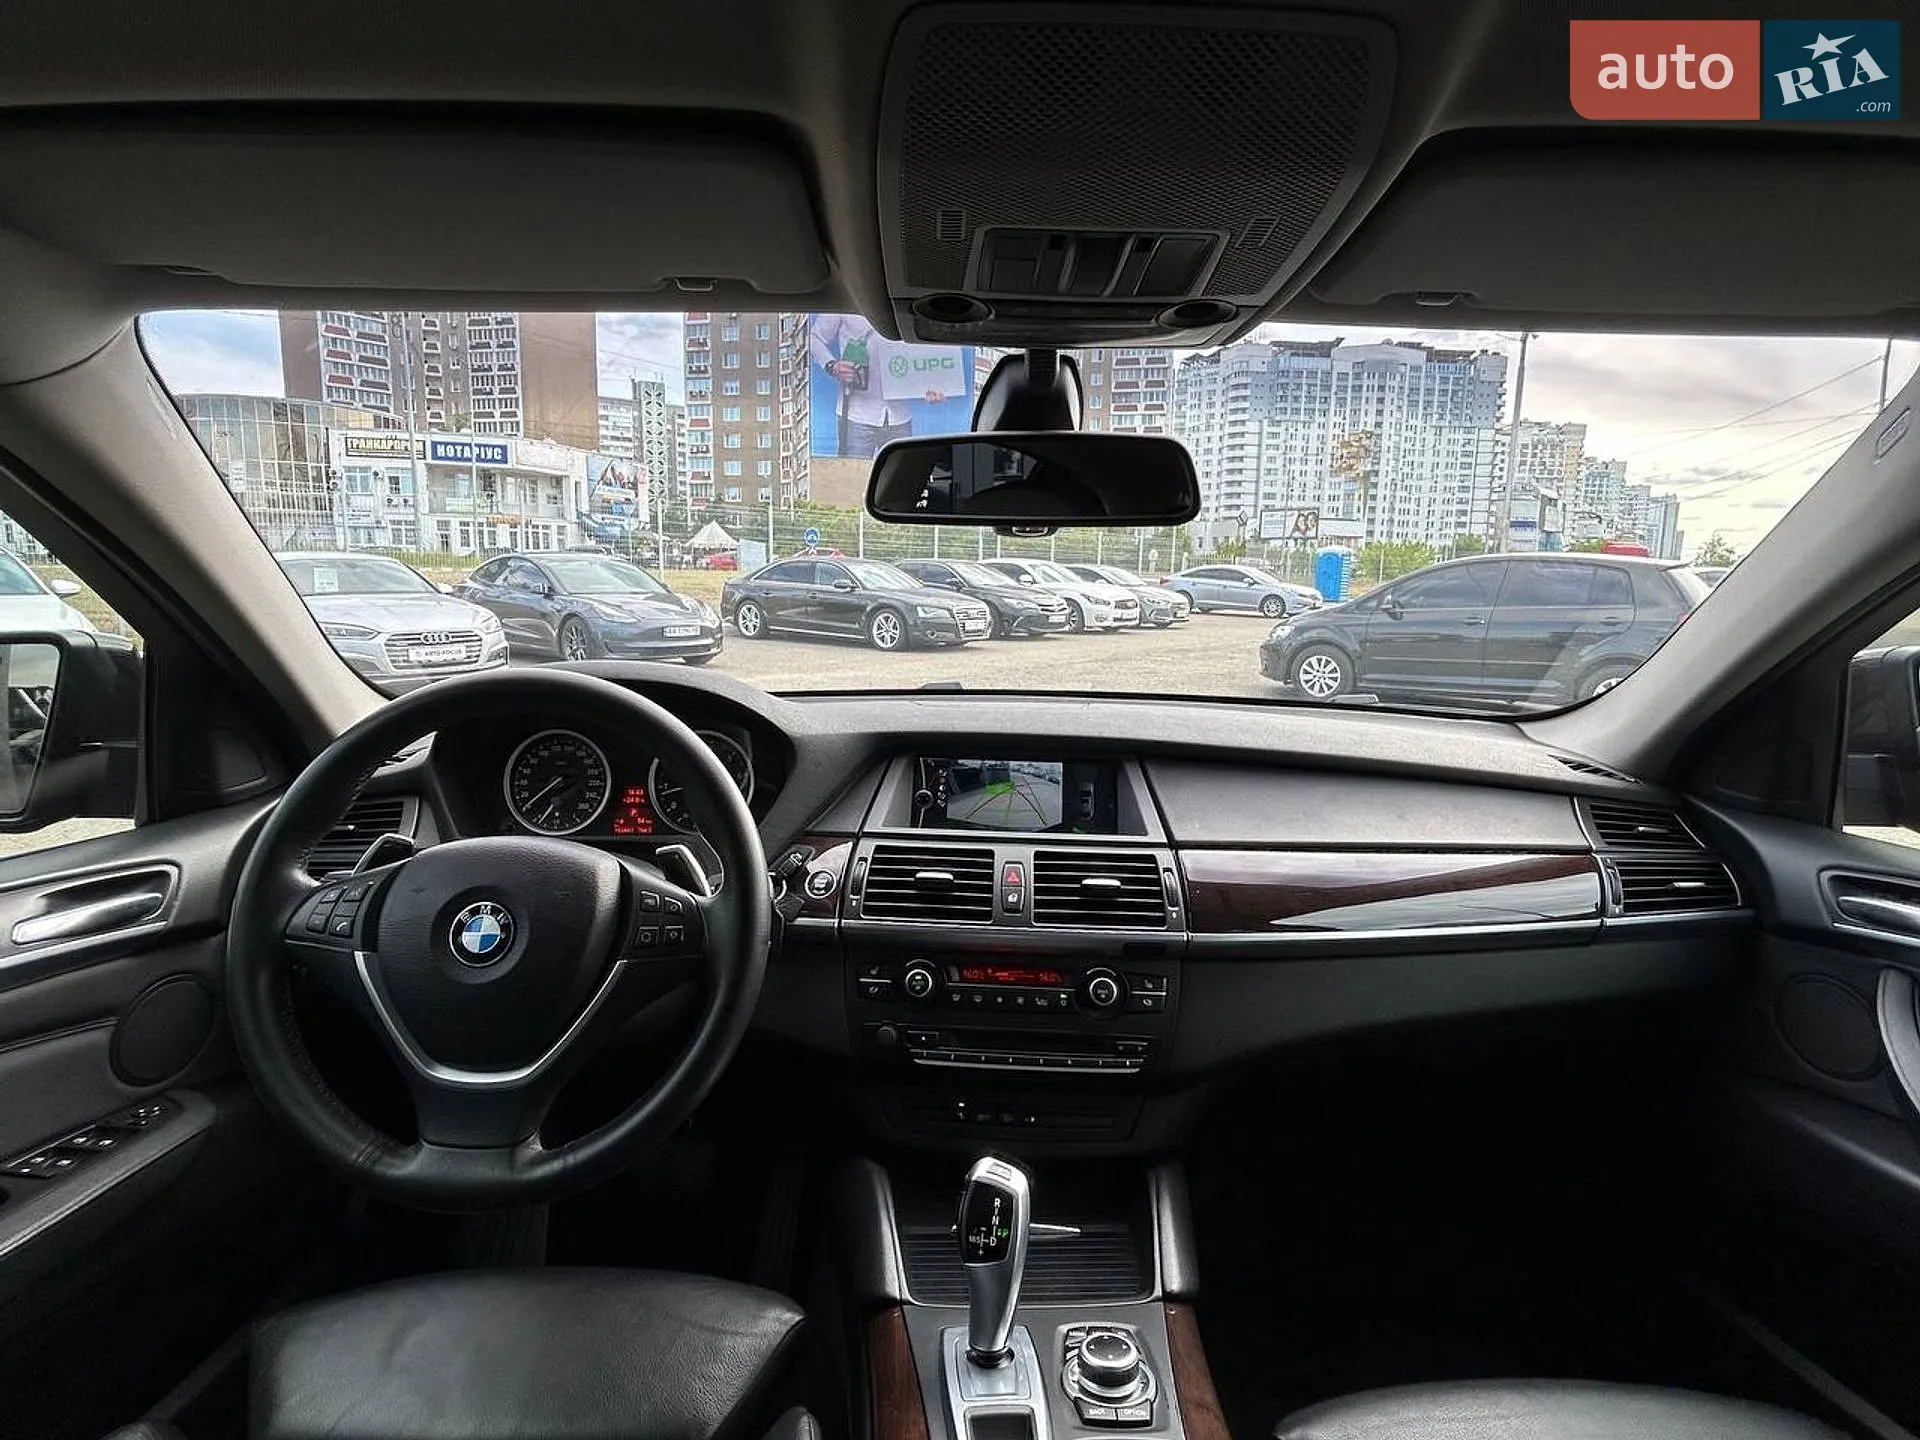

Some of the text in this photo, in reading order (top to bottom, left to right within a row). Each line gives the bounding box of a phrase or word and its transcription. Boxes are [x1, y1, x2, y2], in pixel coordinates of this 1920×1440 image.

[913, 357, 954, 371] UPG
[437, 443, 503, 460] НОТАРІУС
[460, 904, 509, 925] BMW
[994, 1198, 1001, 1208] R
[992, 1215, 999, 1225] N
[990, 1236, 997, 1246] D
